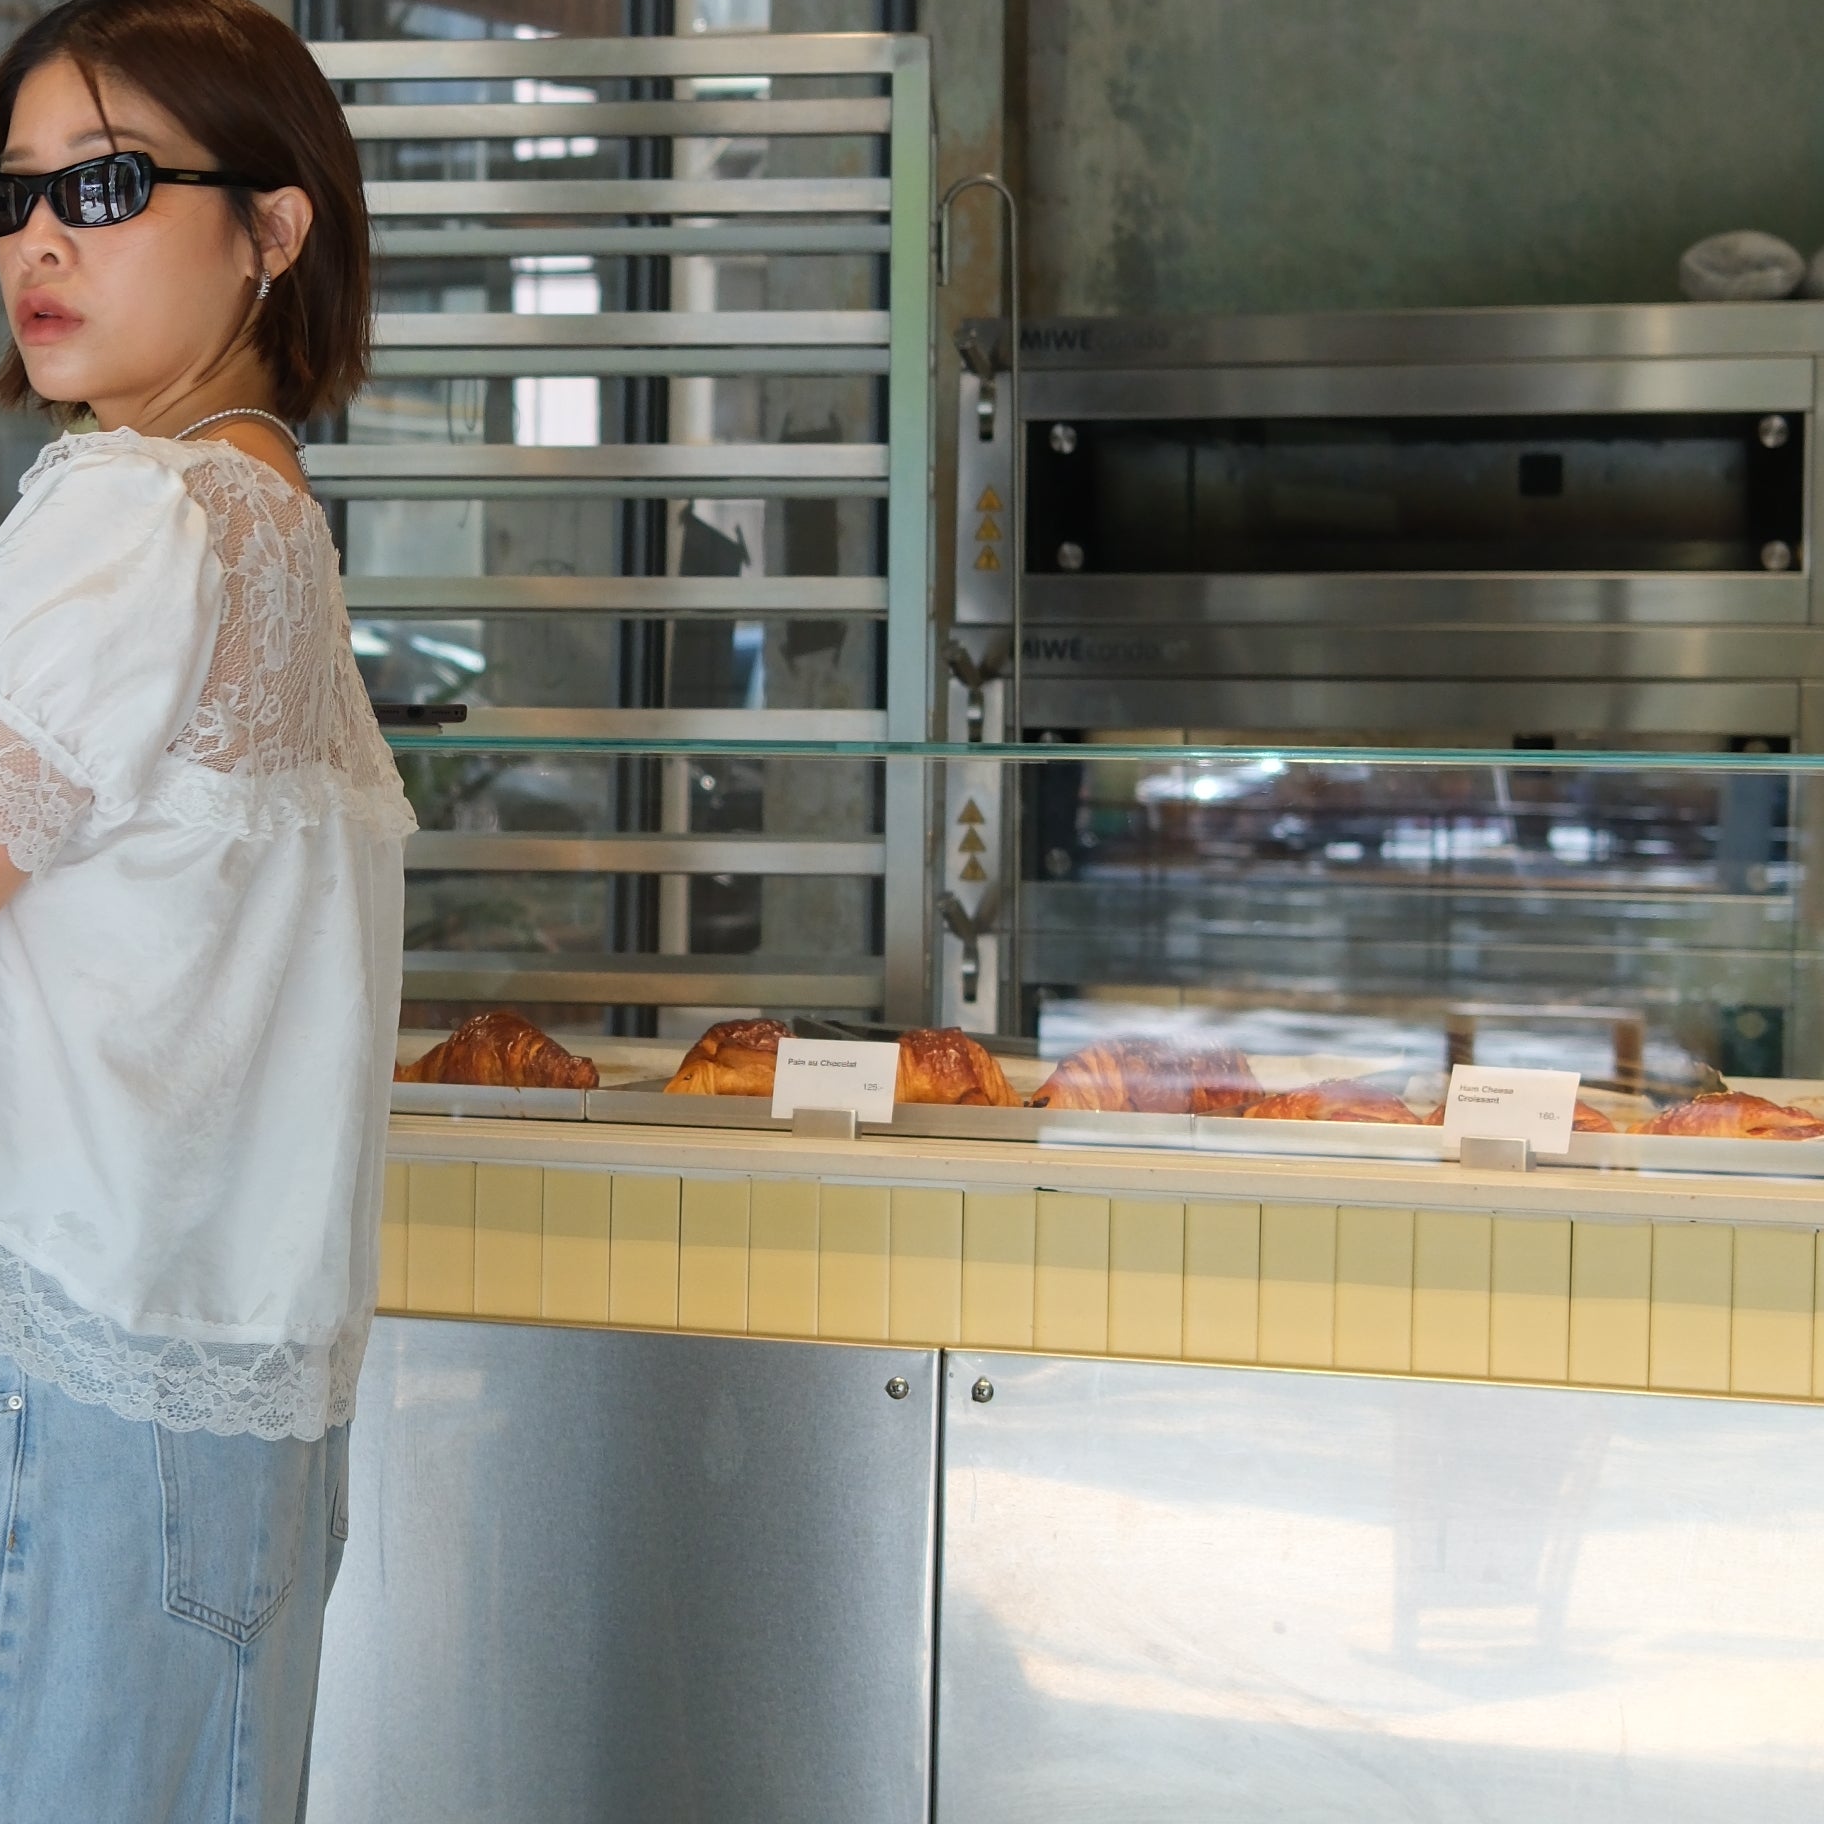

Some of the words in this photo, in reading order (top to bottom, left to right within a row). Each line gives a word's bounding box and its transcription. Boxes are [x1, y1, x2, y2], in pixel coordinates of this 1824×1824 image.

[788, 1058, 806, 1066] Pain
[820, 1059, 857, 1068] Chocolat
[1459, 1084, 1479, 1092] Ham
[1482, 1085, 1514, 1095] Cheese
[1458, 1094, 1500, 1104] Croissant
